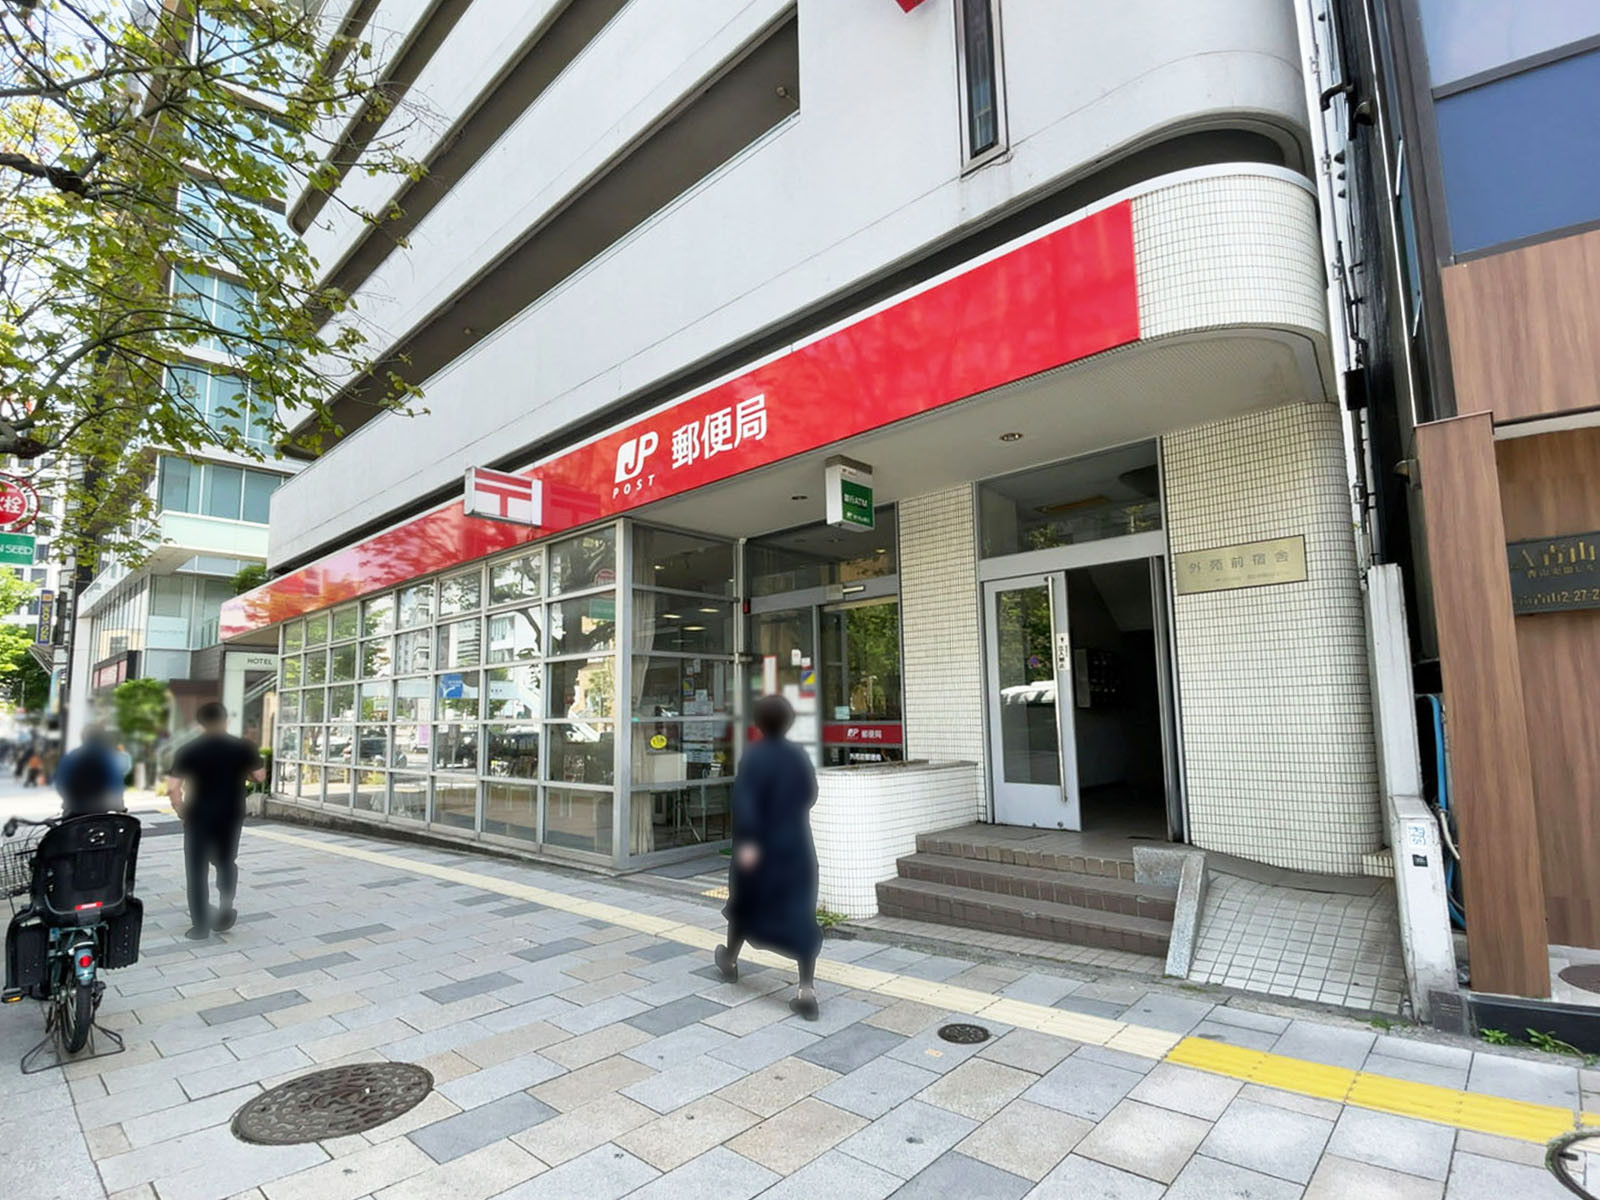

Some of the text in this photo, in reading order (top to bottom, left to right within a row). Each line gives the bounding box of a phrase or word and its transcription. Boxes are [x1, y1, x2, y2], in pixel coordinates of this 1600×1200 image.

[671, 394, 768, 470] 郵便局
[612, 474, 656, 499] POST
[247, 658, 273, 666] HOTEL
